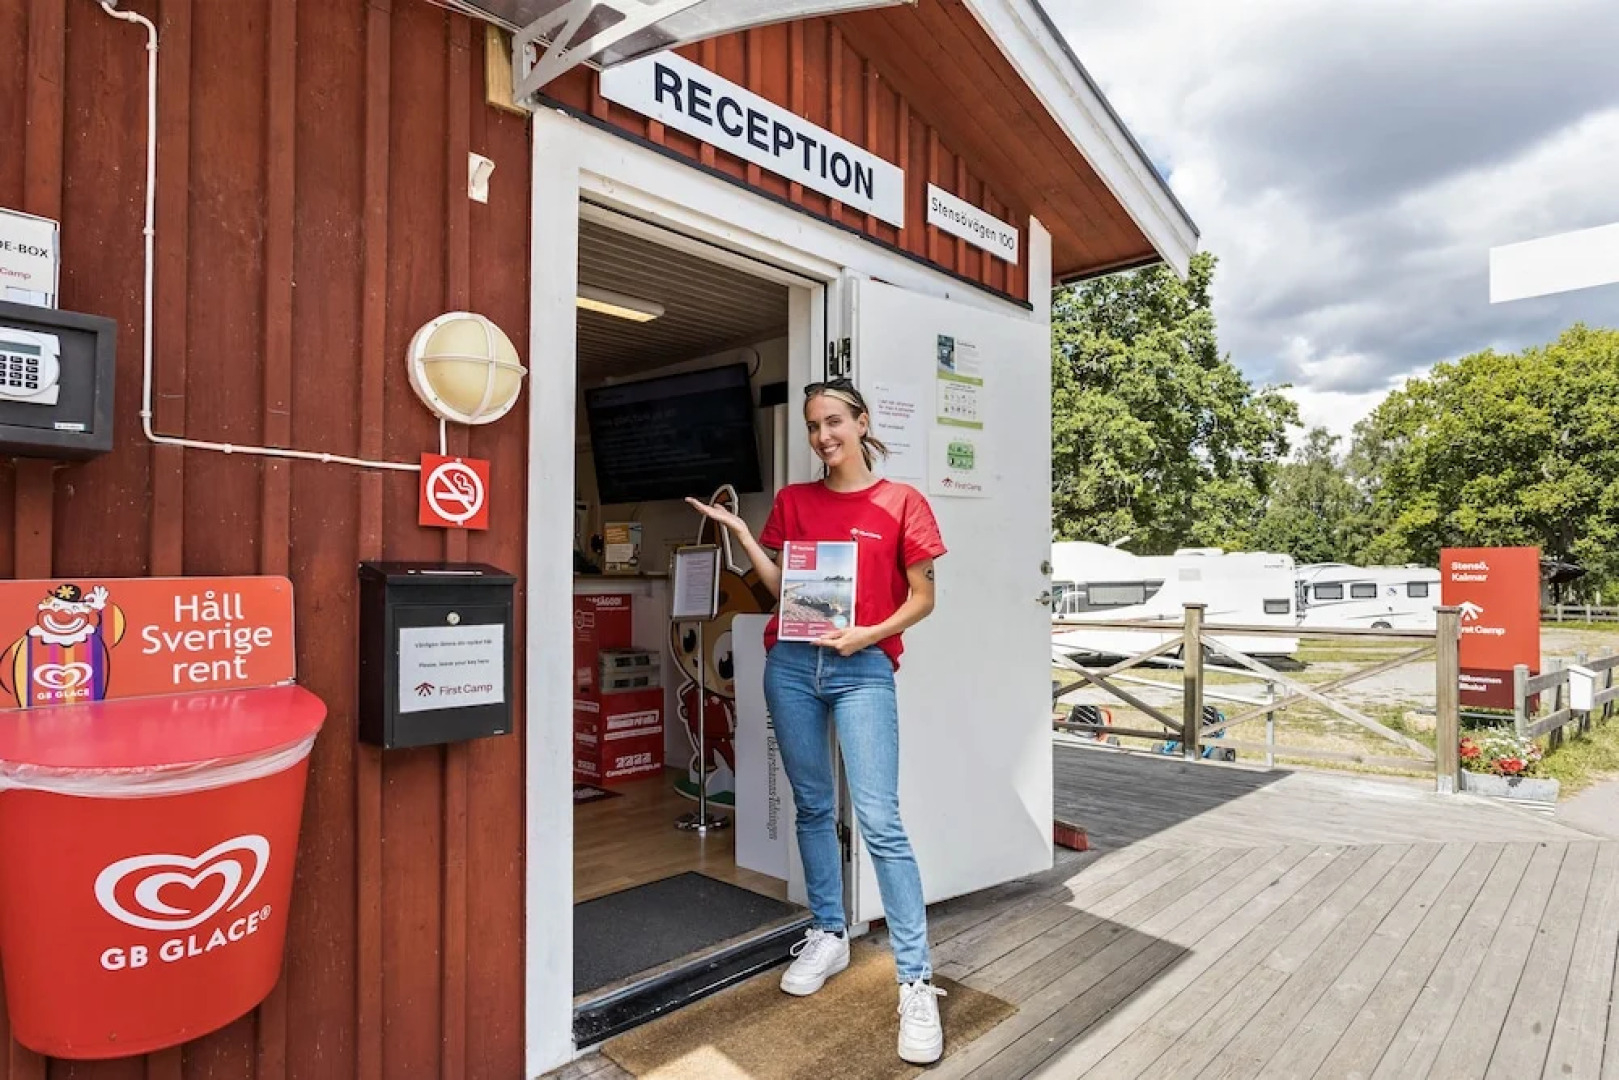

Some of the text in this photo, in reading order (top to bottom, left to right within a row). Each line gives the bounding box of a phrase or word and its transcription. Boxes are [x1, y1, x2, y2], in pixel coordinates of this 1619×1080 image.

[654, 62, 874, 200] RECEPTION
[930, 196, 1016, 250] Stensövägen 100
[1451, 561, 1490, 571] Stensö,
[1451, 572, 1488, 582] Kalmar
[174, 590, 244, 622] Håll
[141, 622, 272, 654] Sverige
[1474, 625, 1506, 636] Camp
[172, 655, 248, 684] rent
[37, 688, 89, 700] GB GLACE
[440, 683, 493, 696] First Camp
[100, 945, 149, 971] GB
